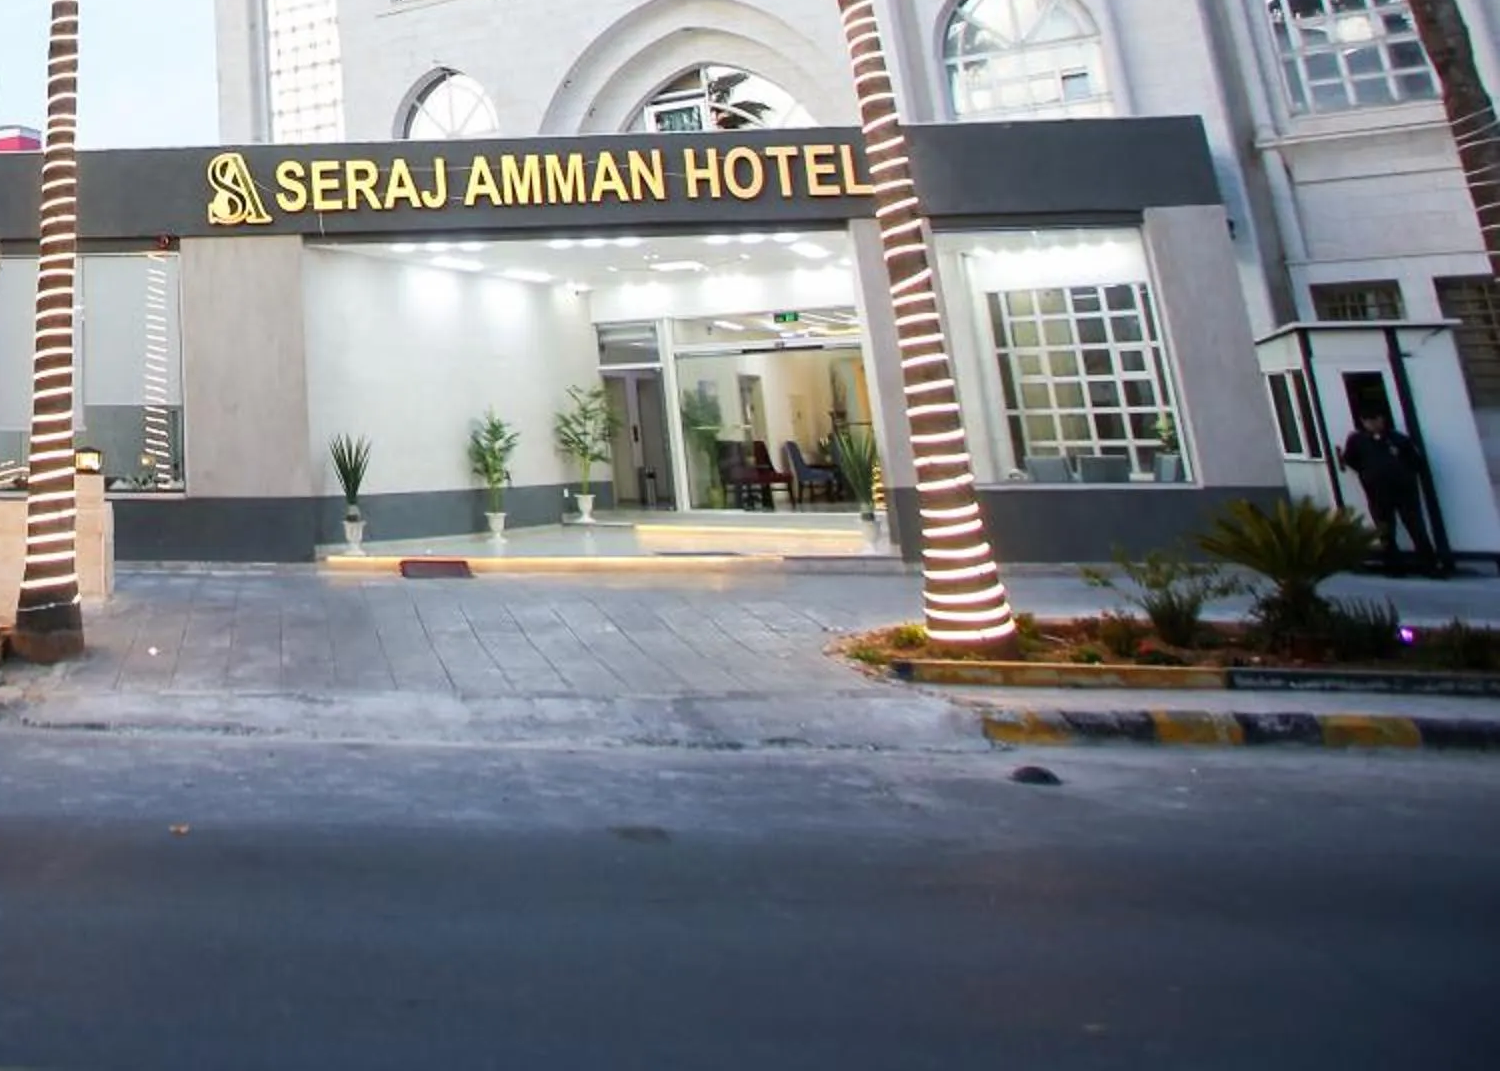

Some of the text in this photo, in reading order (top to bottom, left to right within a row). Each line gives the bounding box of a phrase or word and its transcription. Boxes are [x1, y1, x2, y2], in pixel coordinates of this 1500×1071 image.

[275, 144, 876, 212] SERAJ AMMAN HOTEL
